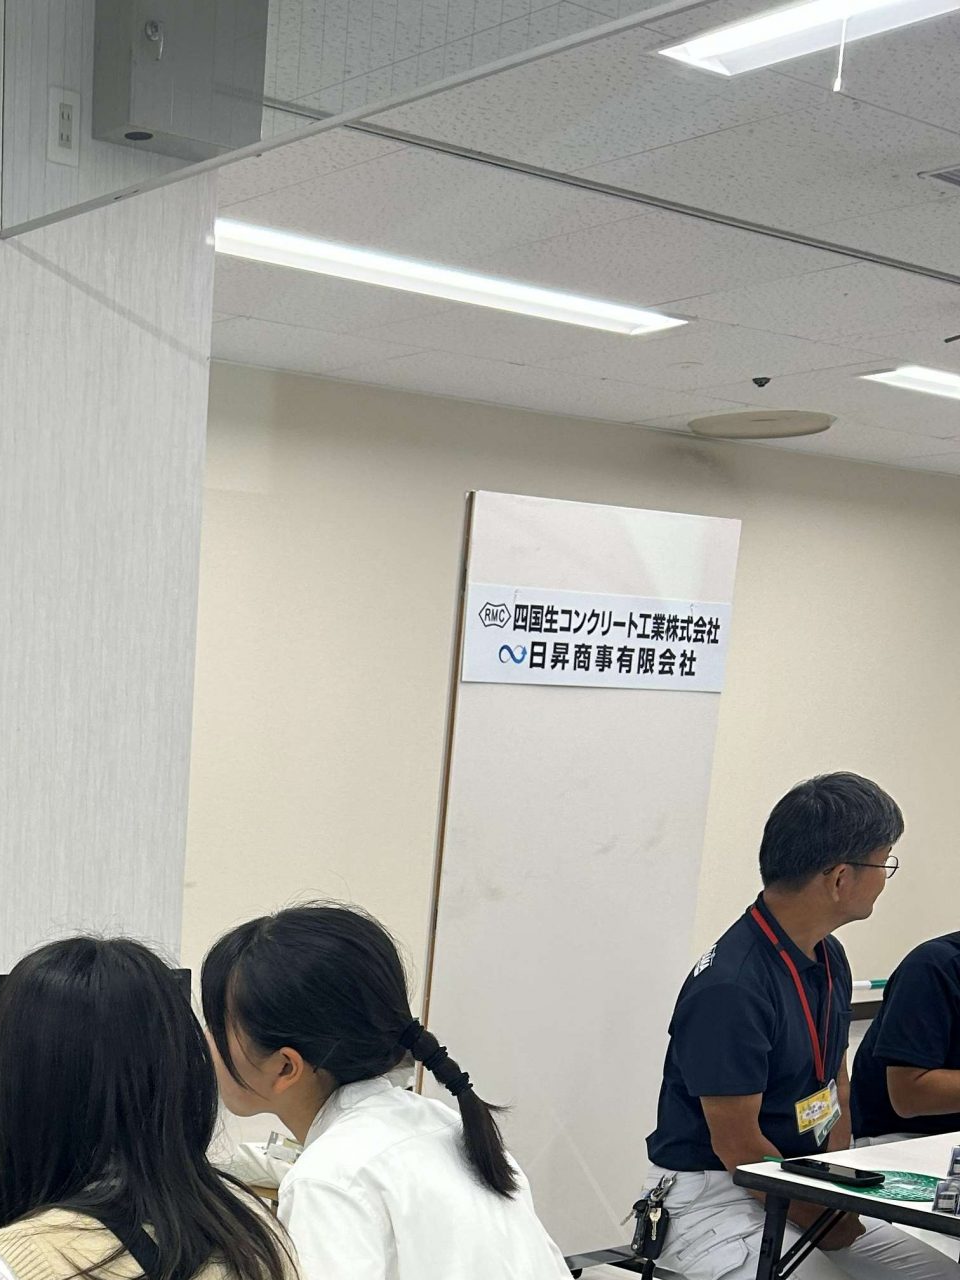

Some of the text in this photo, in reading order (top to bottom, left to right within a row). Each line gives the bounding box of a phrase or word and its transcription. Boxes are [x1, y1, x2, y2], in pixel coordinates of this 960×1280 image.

[484, 606, 506, 623] RMC
[513, 604, 720, 644] 四国生コンクリート工業株式会社
[529, 641, 697, 676] 日昇商事有限会社
